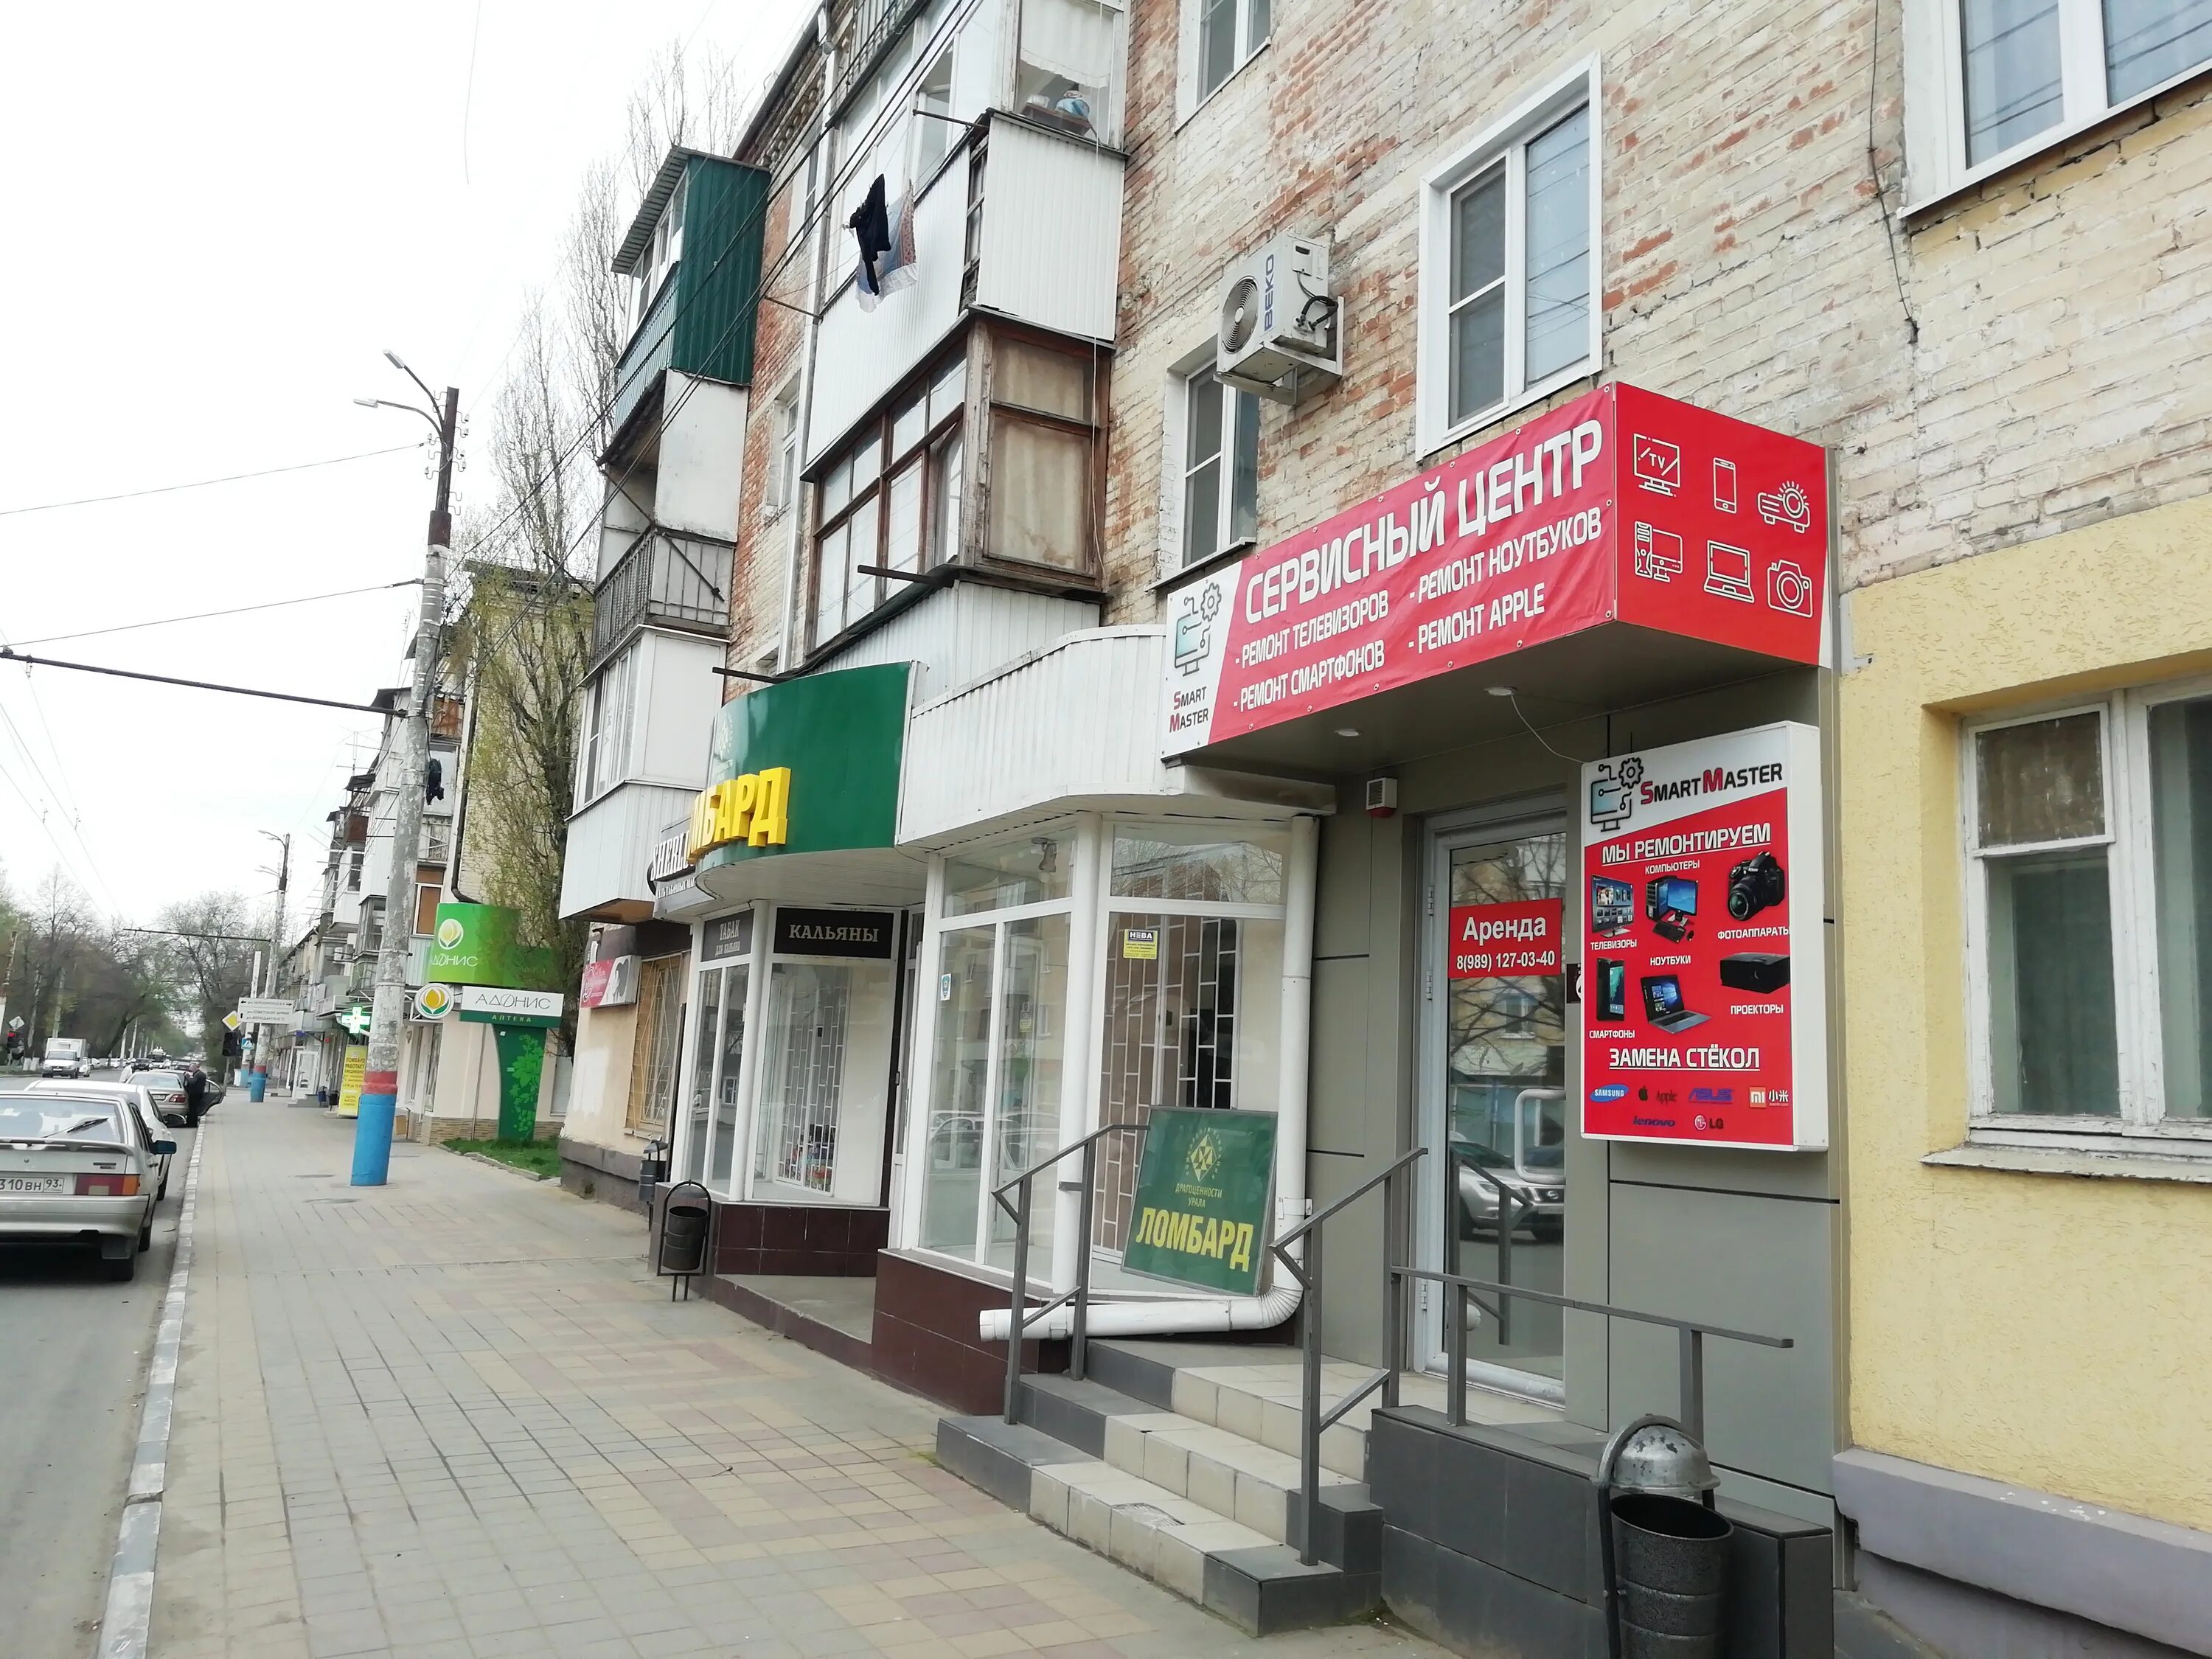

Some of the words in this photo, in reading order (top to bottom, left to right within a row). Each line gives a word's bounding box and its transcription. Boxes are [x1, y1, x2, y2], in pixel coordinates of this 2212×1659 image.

[1265, 254, 1274, 332] BEKO
[1649, 453, 1666, 469] TV
[1246, 475, 1445, 625] СЕРВИСНЫЙ
[1458, 419, 1603, 538] ЦЕНТР
[1419, 556, 1484, 604] РЕМОНТ
[1489, 507, 1602, 577] НОУТБУКОВ
[1418, 606, 1484, 654] РЕМОНТ
[1489, 582, 1545, 630] APPLE
[1242, 631, 1290, 669] РЕМОНТ
[1293, 589, 1389, 650] ТЕЛЕВИЗОРОВ
[1240, 674, 1287, 713] РЕМОНТ
[1290, 641, 1385, 697] СМАРТФОНОВ
[1601, 843, 1630, 864] МЫ
[1635, 822, 1771, 859] РЕМОНТИРУЕМ
[1645, 860, 1700, 875] КОМПЬЮТЕРЫ
[720, 919, 740, 941] ТАБАК
[789, 924, 879, 942] КАЛЬЯНЫ
[1462, 917, 1546, 946] Аренда
[1717, 926, 1791, 941] ФОТОАППАРАТЫ
[1590, 939, 1638, 950] ТЕЛЕВИЗОРЫ
[1456, 953, 1492, 973] 8(989)
[1495, 950, 1555, 968] 127-03-40
[1650, 955, 1691, 967] НОУТБУКИ
[475, 993, 551, 1009] АДОНИС
[1731, 1004, 1784, 1015] ПРОЕКТОРЫ
[491, 1014, 532, 1023] АПТЕКА
[1589, 1029, 1635, 1040] СМАРТФОНЫ
[1609, 1048, 1681, 1067] ЗАМЕНА
[1686, 1043, 1760, 1068] СТЁКОЛ
[1594, 1089, 1624, 1097] SAMSUNG
[1656, 1091, 1677, 1104] Apple
[1709, 1119, 1724, 1129] LG
[1175, 1183, 1222, 1198] ДРАГОЦЕННОСТИ
[1188, 1197, 1206, 1208] УРАЛА
[1135, 1207, 1254, 1273] ЛОМБАРД
